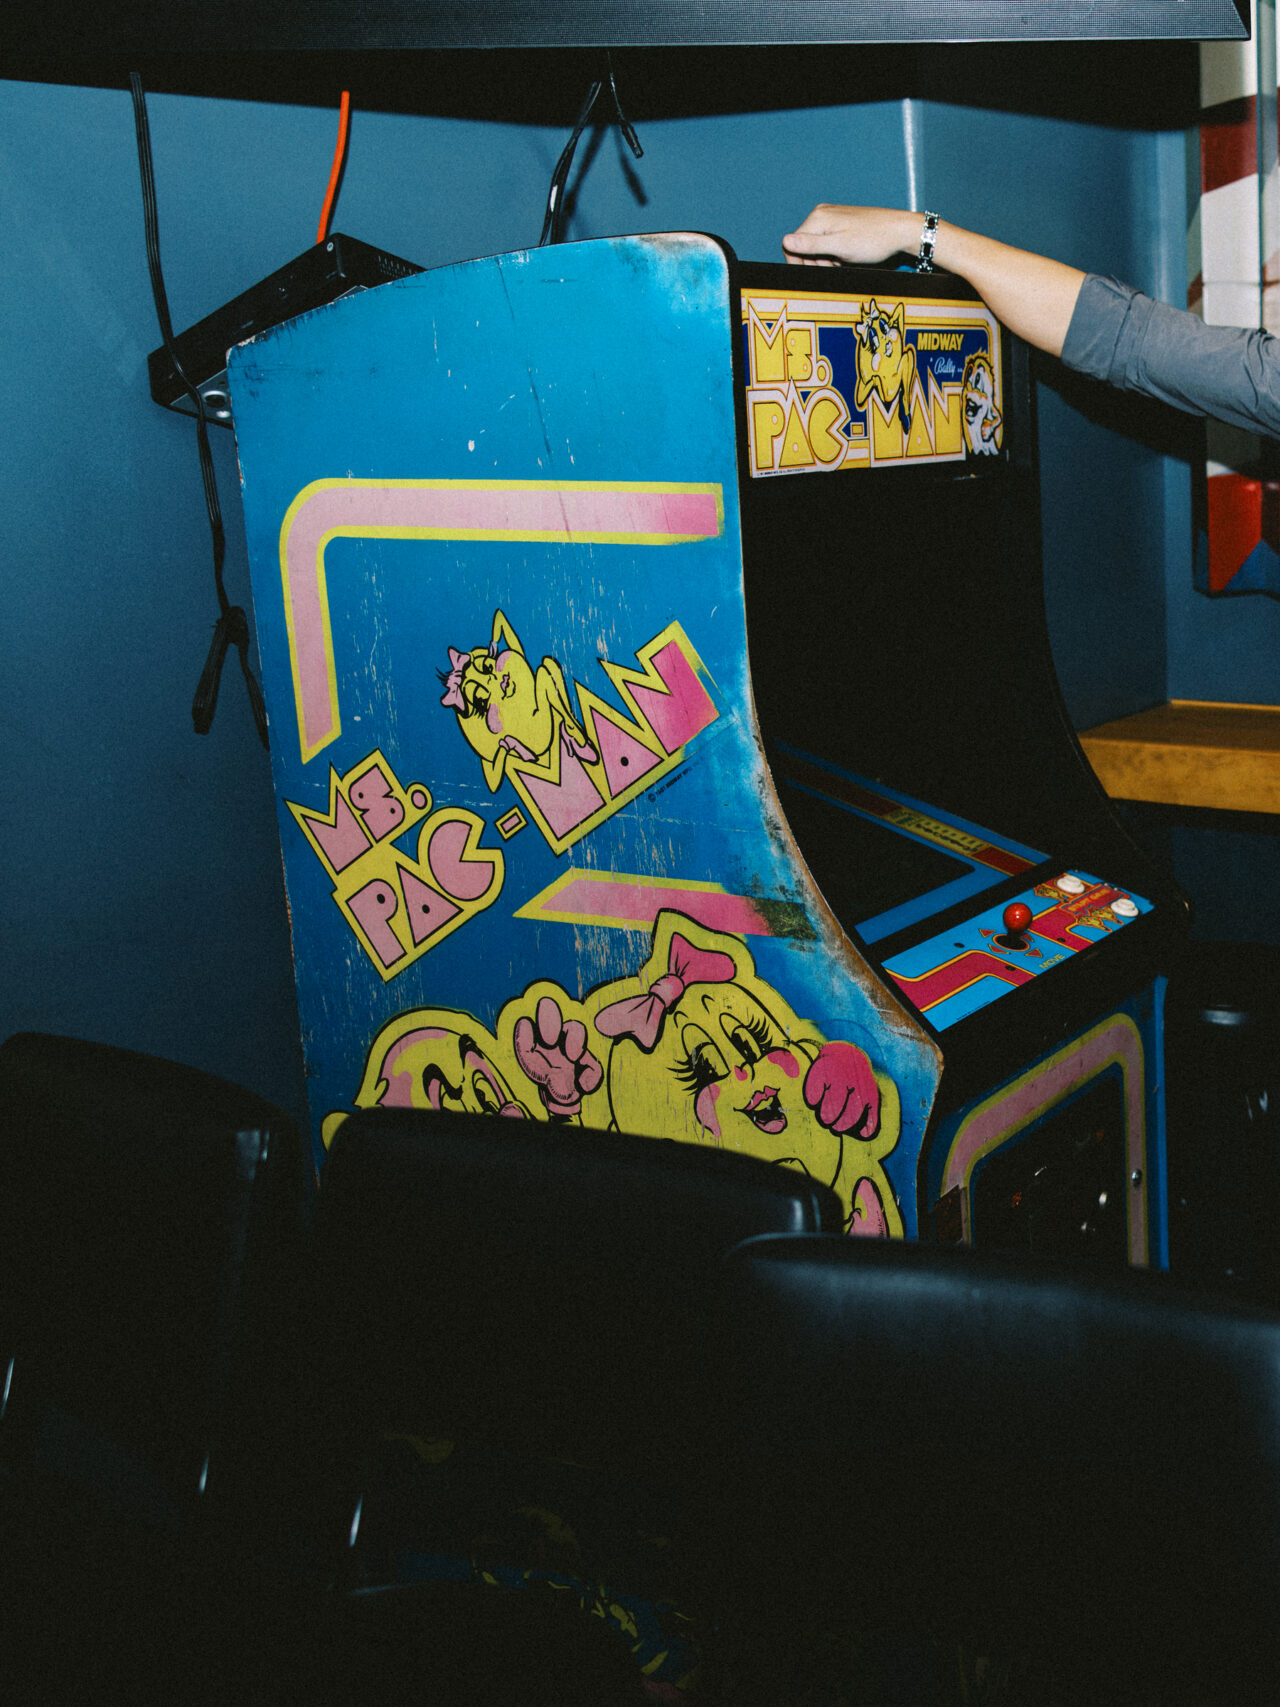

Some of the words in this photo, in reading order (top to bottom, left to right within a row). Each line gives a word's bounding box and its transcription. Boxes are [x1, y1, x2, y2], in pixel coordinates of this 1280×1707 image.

[917, 332, 964, 351] MIDWAY
[934, 356, 956, 378] Bally
[750, 382, 964, 472] PAC-MAN
[331, 620, 720, 982] PAC-MAN
[1039, 954, 1065, 969] MOVE
